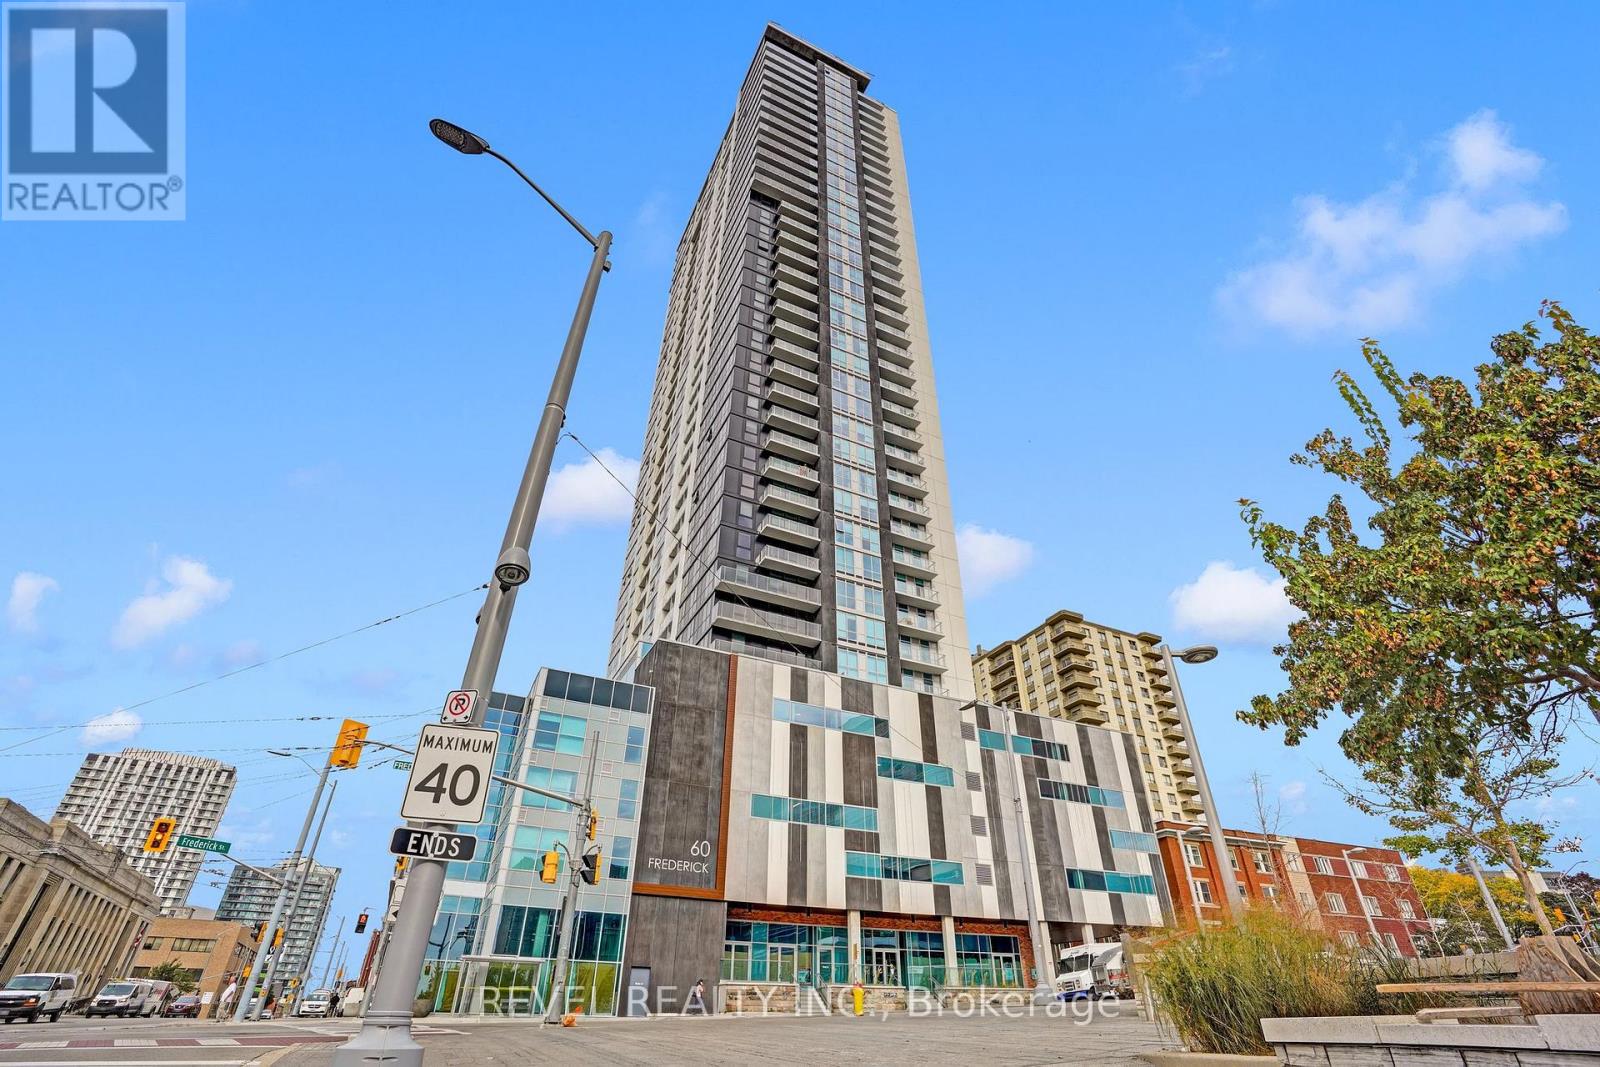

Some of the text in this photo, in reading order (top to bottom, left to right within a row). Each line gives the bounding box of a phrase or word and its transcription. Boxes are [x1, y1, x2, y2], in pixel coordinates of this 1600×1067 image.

[423, 734, 494, 754] MAXIMUM
[414, 762, 481, 806] 40
[181, 837, 217, 851] Frederick
[406, 833, 461, 857] ENDS
[690, 840, 711, 857] 60
[648, 857, 709, 873] FREDERICK
